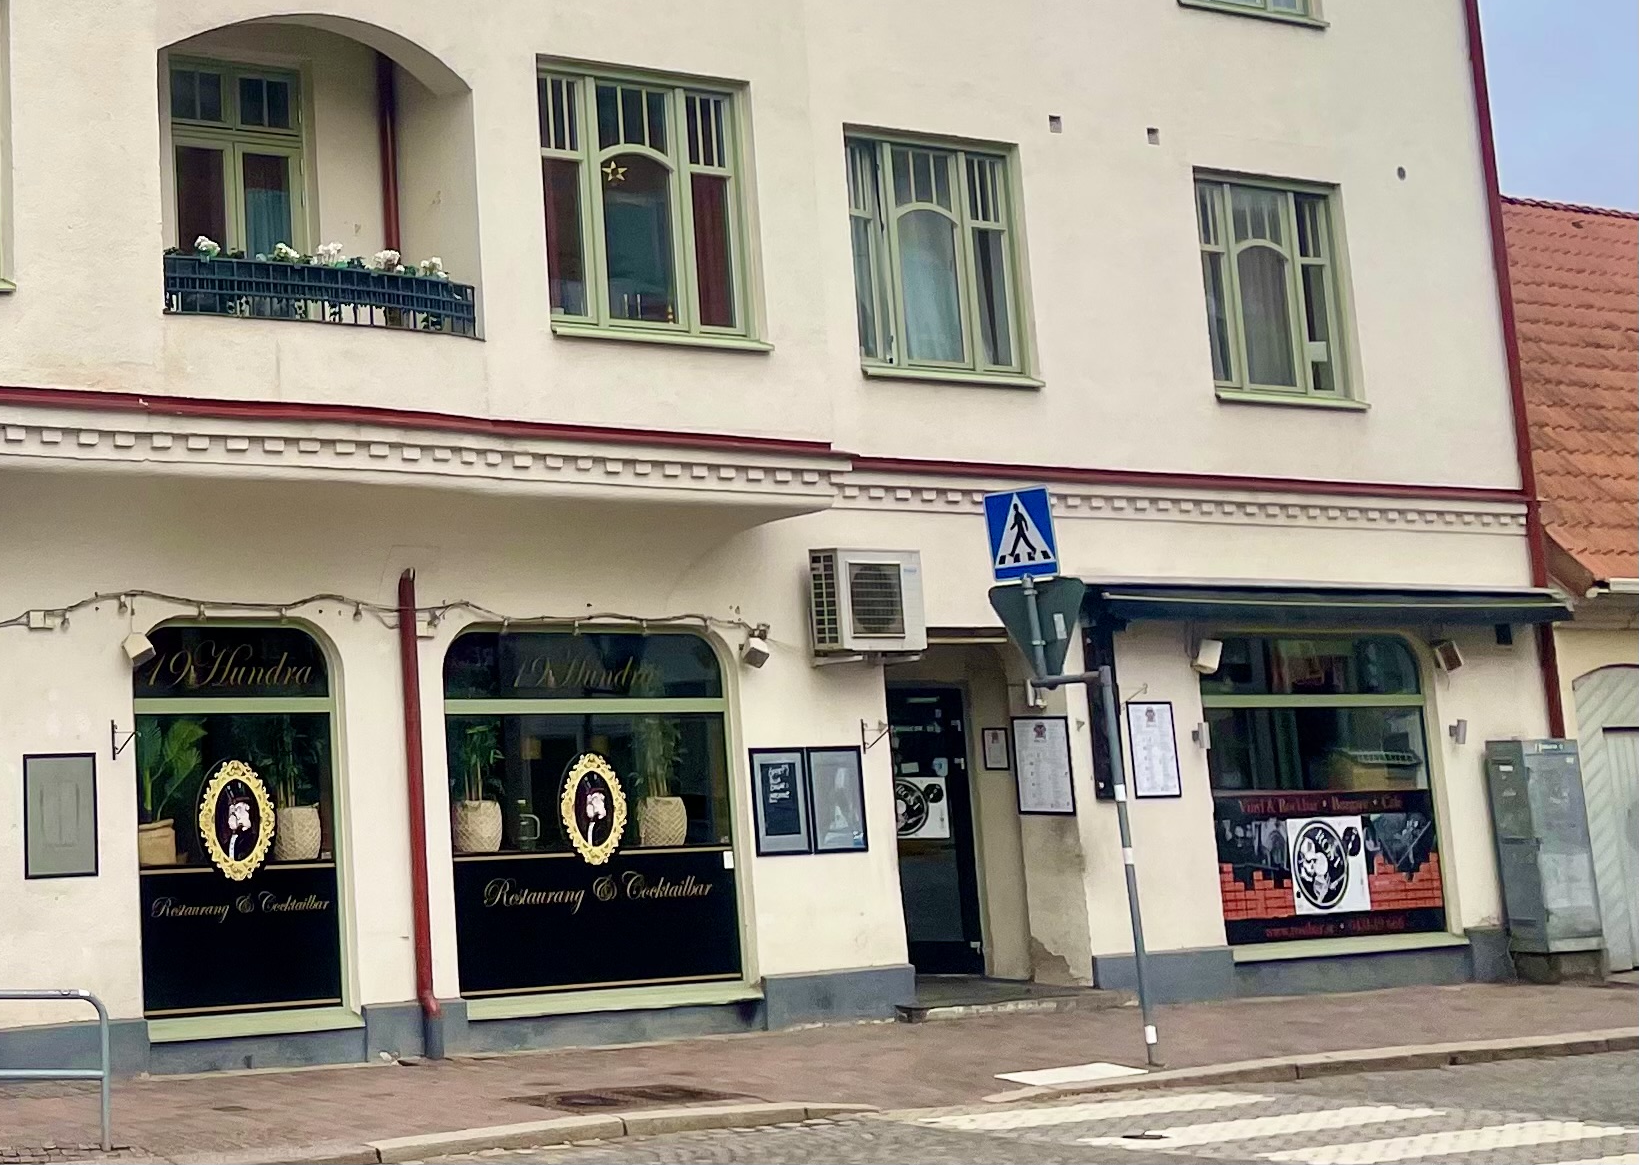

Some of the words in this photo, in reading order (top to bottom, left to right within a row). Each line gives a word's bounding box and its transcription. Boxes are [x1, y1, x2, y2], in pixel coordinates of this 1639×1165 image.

[148, 649, 193, 688] 19
[193, 640, 311, 687] Hundra
[514, 655, 550, 687] 19
[561, 649, 653, 687] Hundra
[151, 897, 229, 923] Restaurang
[235, 892, 255, 914] &
[258, 891, 330, 913] Cocktailbar
[484, 877, 585, 915] Restaurang
[593, 875, 617, 901] &
[622, 870, 712, 900] Cocktailbar
